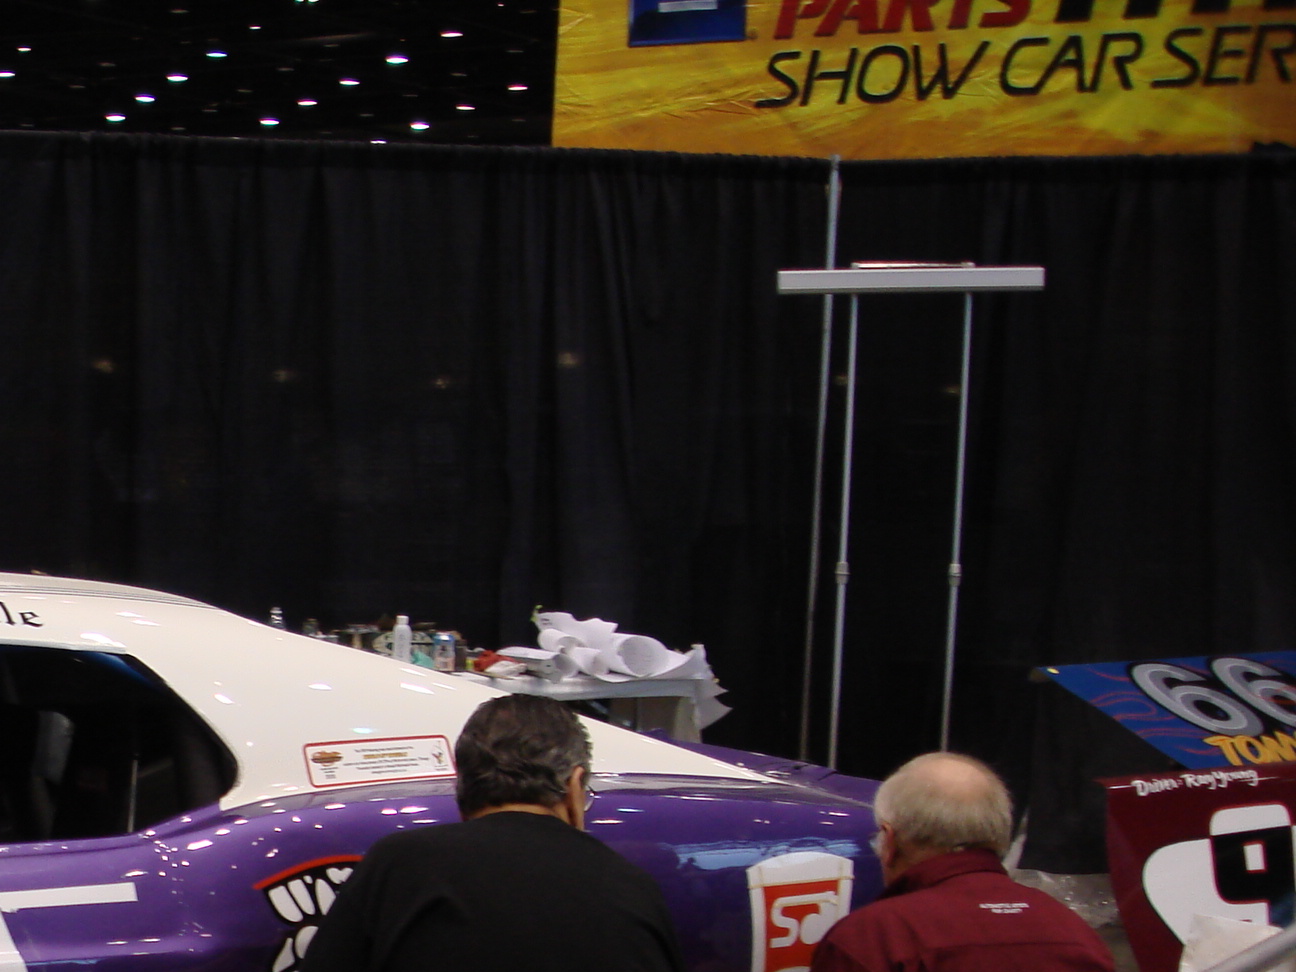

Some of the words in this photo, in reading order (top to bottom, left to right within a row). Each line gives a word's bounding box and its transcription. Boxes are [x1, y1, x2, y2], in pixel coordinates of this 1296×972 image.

[754, 40, 991, 108] SHOW
[1001, 32, 1144, 96] CAR
[1130, 656, 1296, 738] 66
